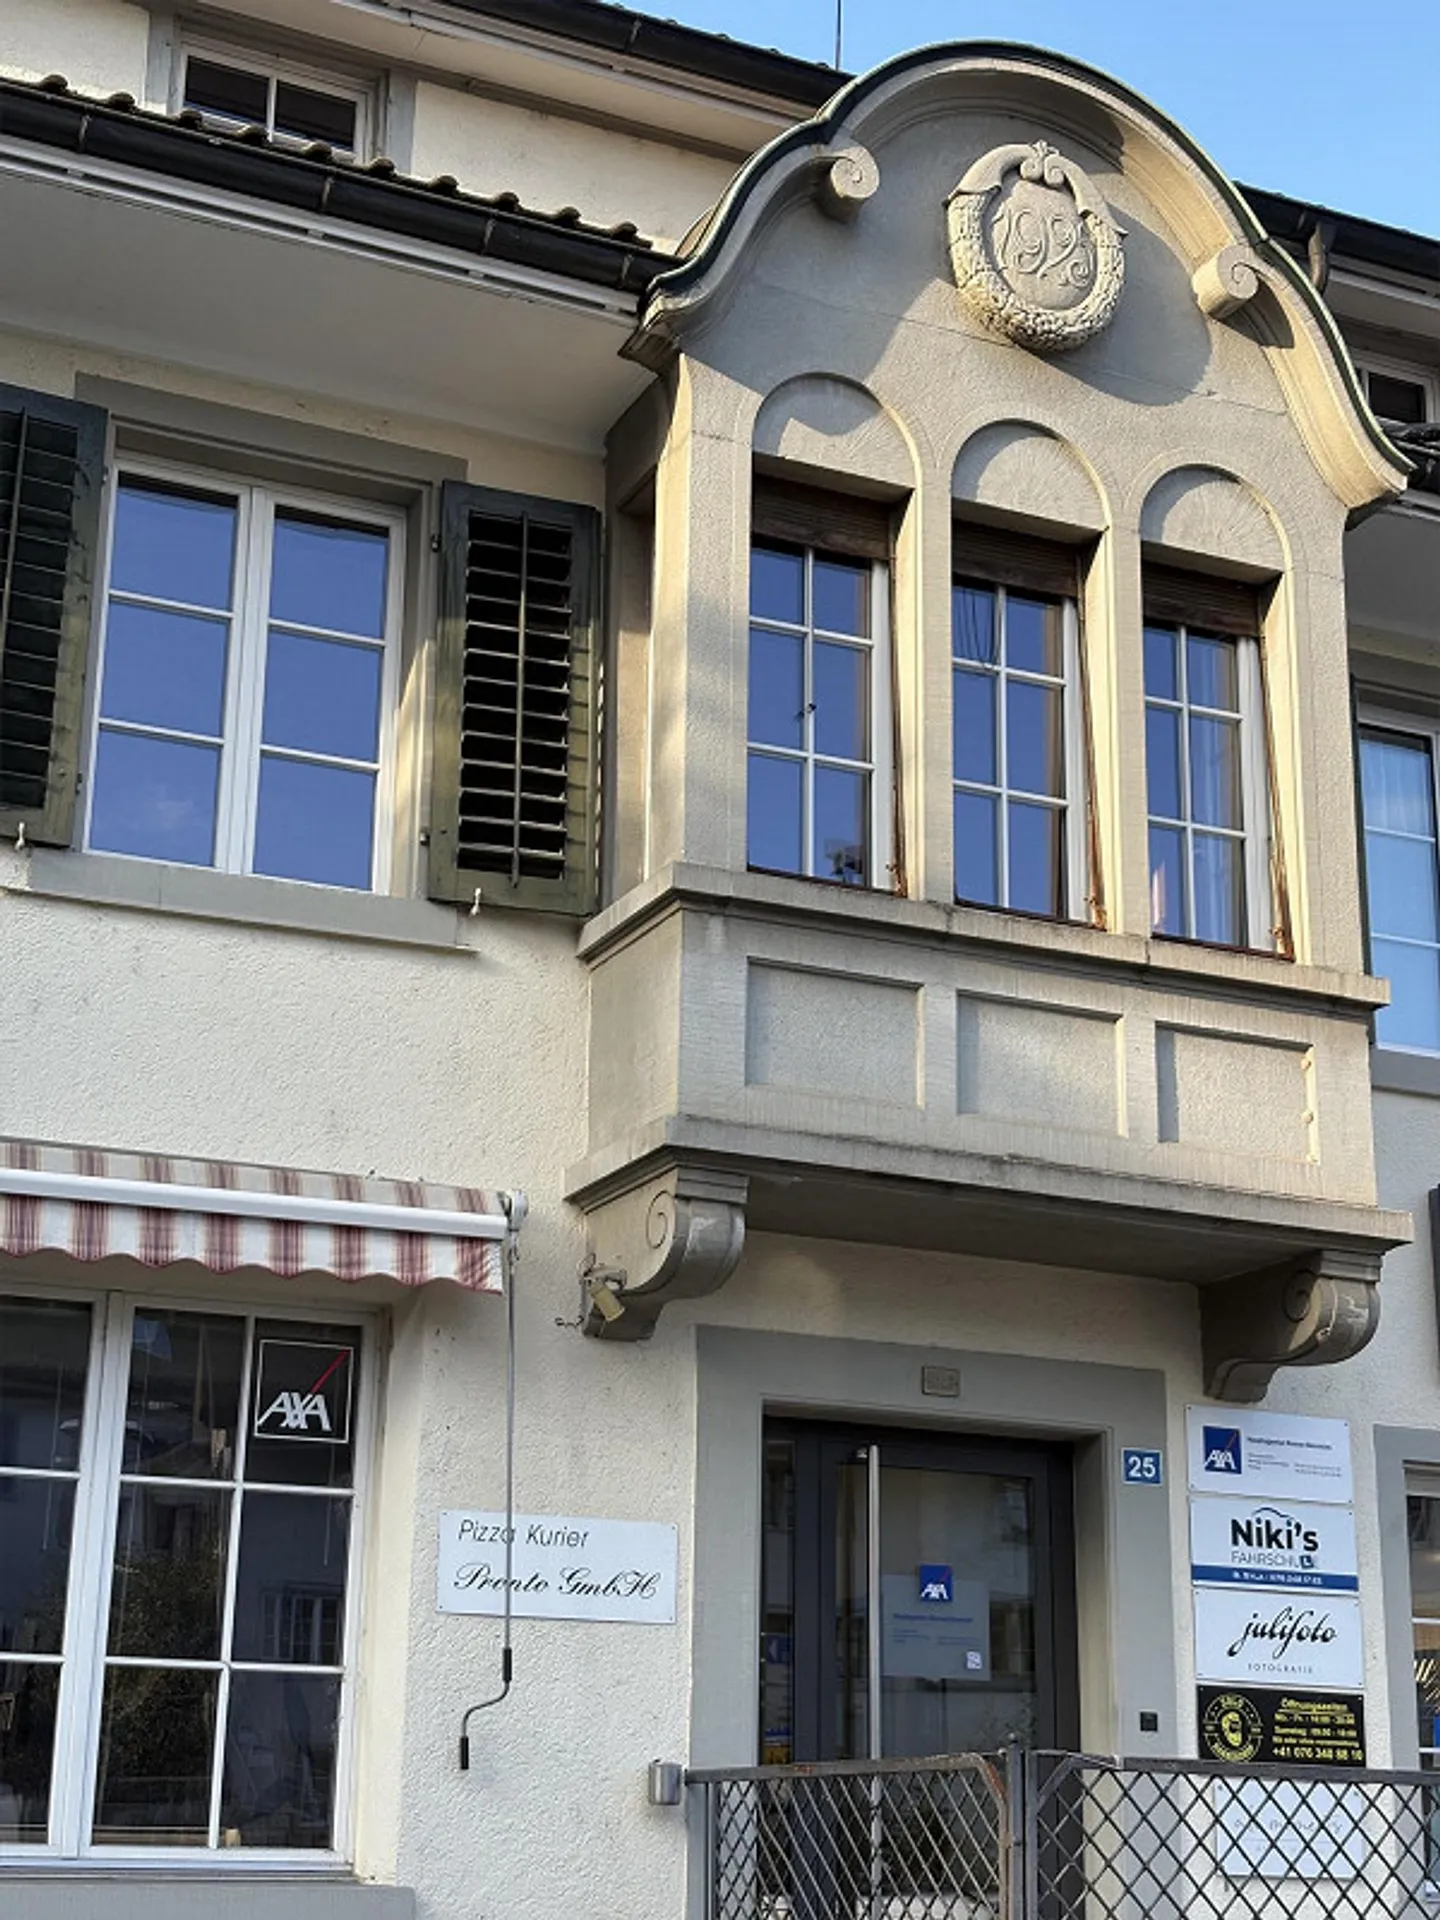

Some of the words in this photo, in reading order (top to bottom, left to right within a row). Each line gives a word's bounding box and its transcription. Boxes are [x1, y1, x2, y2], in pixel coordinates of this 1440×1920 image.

[256, 1391, 332, 1431] AXA
[1128, 1456, 1156, 1478] 25
[1204, 1449, 1236, 1470] AXA
[458, 1519, 516, 1544] Pizza
[526, 1523, 589, 1548] Kurier
[1231, 1517, 1319, 1552] Niki's
[453, 1561, 549, 1591] Pronto
[558, 1566, 661, 1600] GmbH
[921, 1583, 949, 1599] AXA
[1227, 1605, 1337, 1660] julifoto
